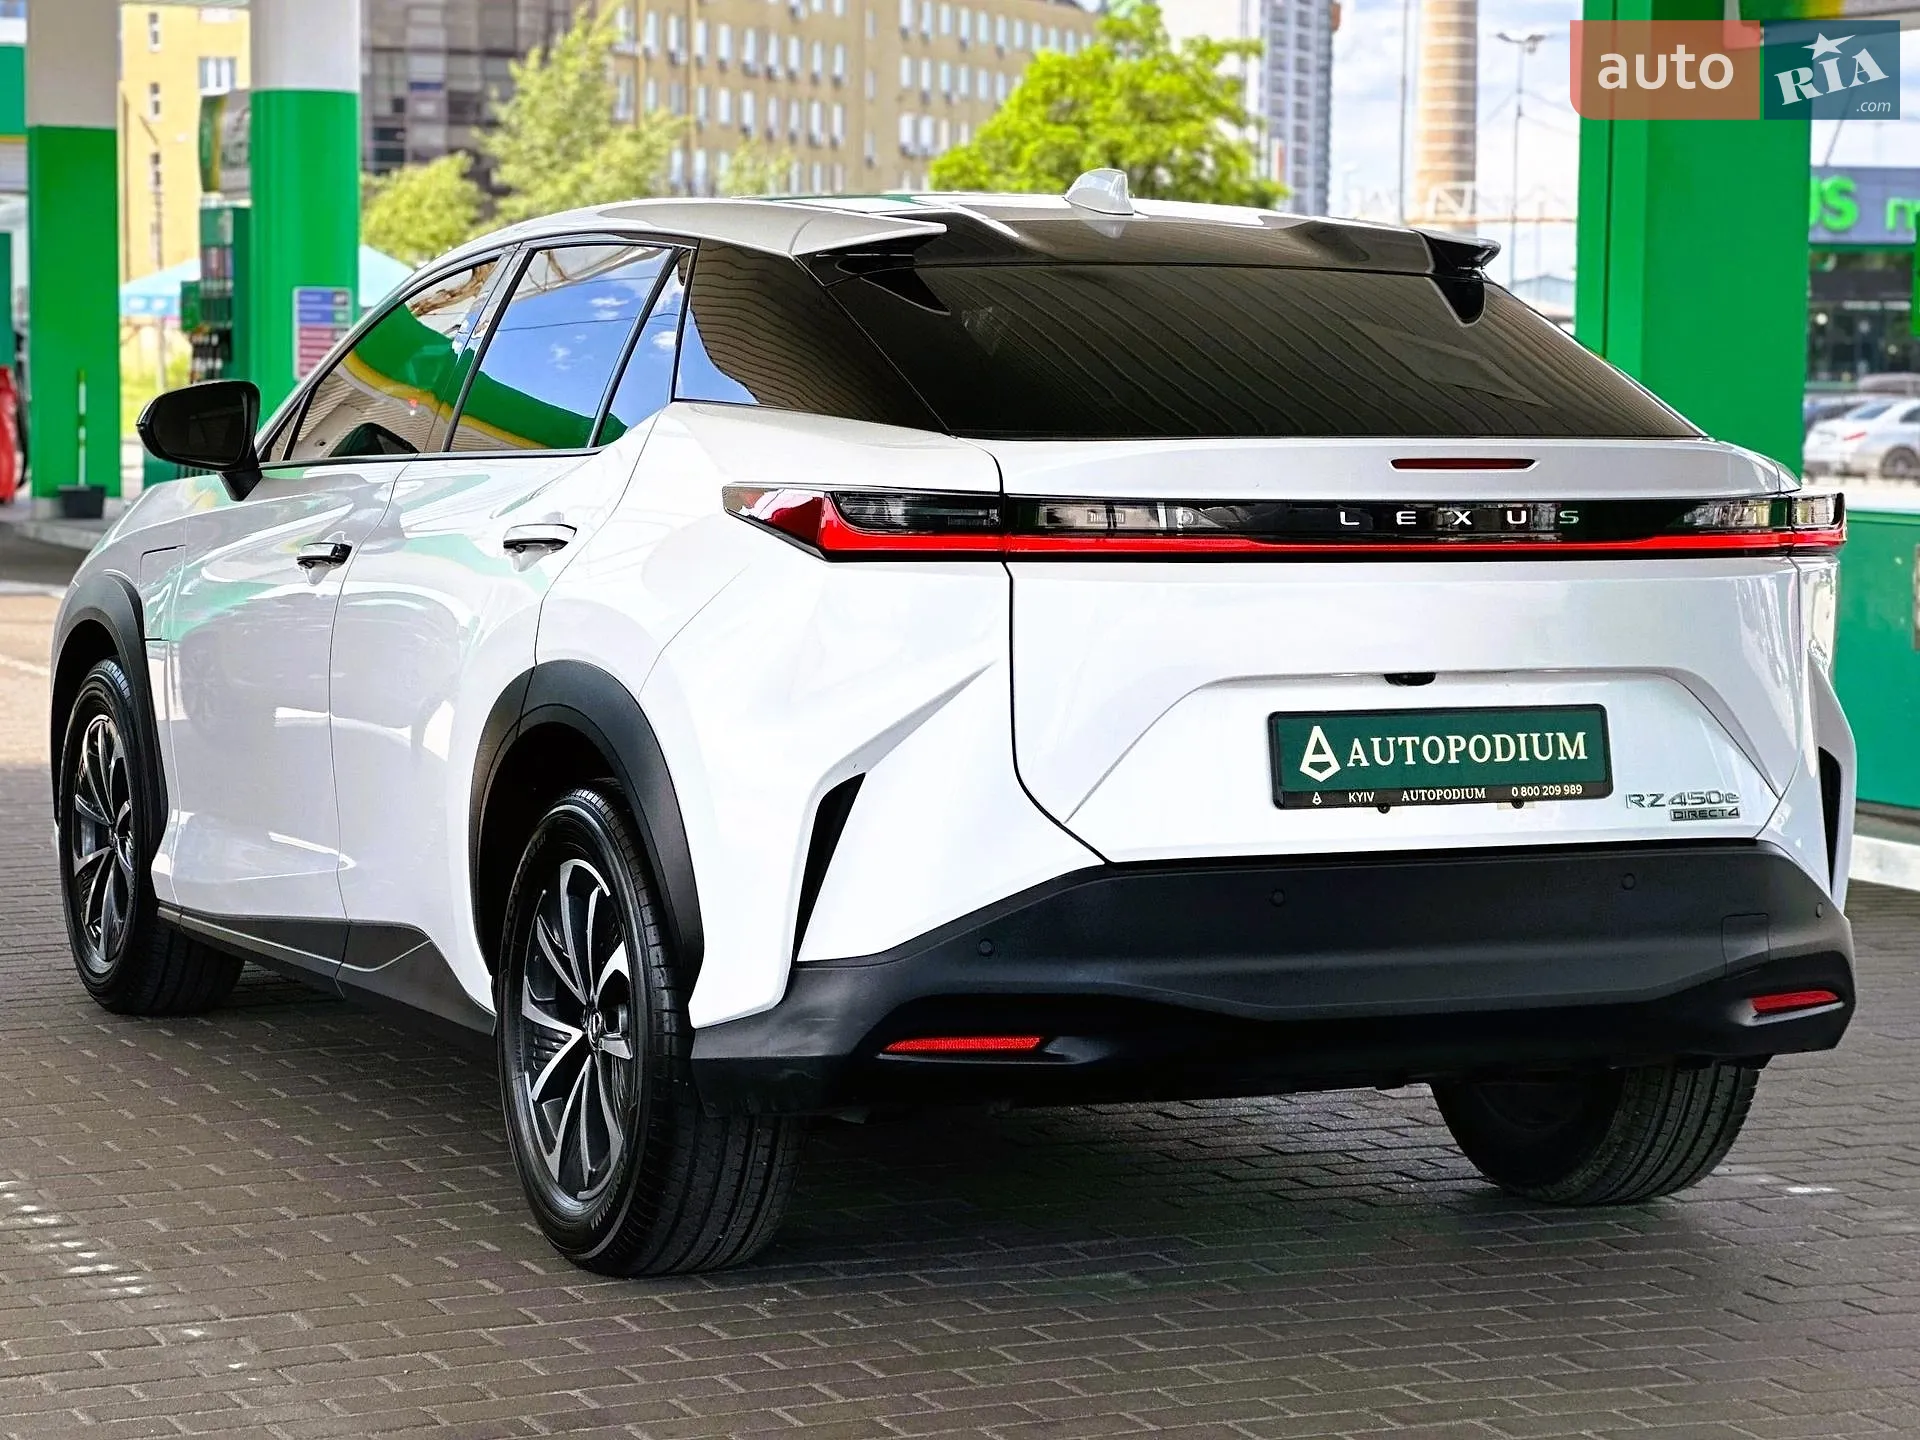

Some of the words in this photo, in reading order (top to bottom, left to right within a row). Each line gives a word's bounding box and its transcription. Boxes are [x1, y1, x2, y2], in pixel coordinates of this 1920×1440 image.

[1340, 510, 1579, 526] LEXUS
[1347, 731, 1588, 767] AUTOPODIUM
[1348, 791, 1375, 803] KYIV
[1401, 787, 1486, 801] AUTOPODIUM
[1511, 787, 1518, 797] 0
[1520, 786, 1541, 797] 800
[1542, 785, 1562, 797] 209
[1563, 783, 1583, 795] 989
[1626, 793, 1666, 808] RZ
[1668, 789, 1740, 806] 450e
[1673, 807, 1739, 820] DIRECT4
